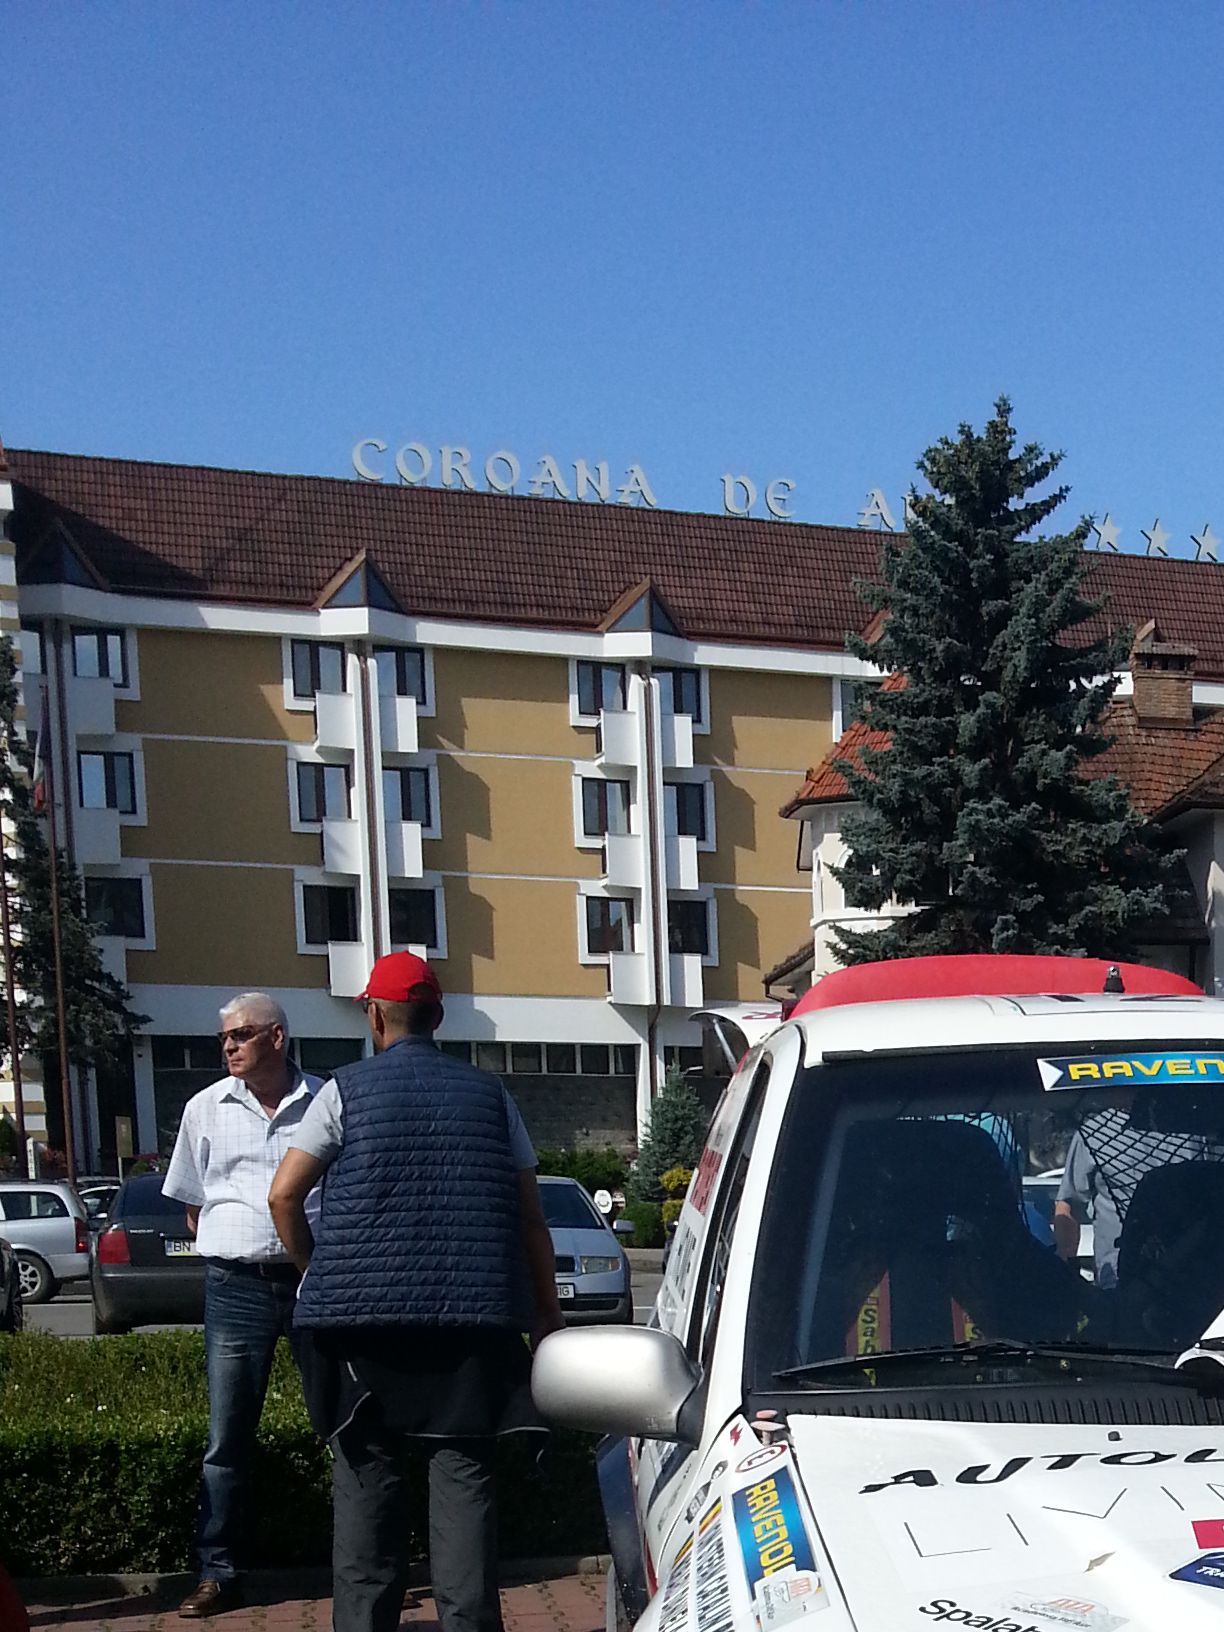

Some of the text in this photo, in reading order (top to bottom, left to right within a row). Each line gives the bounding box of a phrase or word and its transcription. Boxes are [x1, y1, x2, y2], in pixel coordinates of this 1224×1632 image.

[351, 437, 658, 509] COROANA
[722, 474, 797, 519] DE
[173, 1241, 191, 1252] BN
